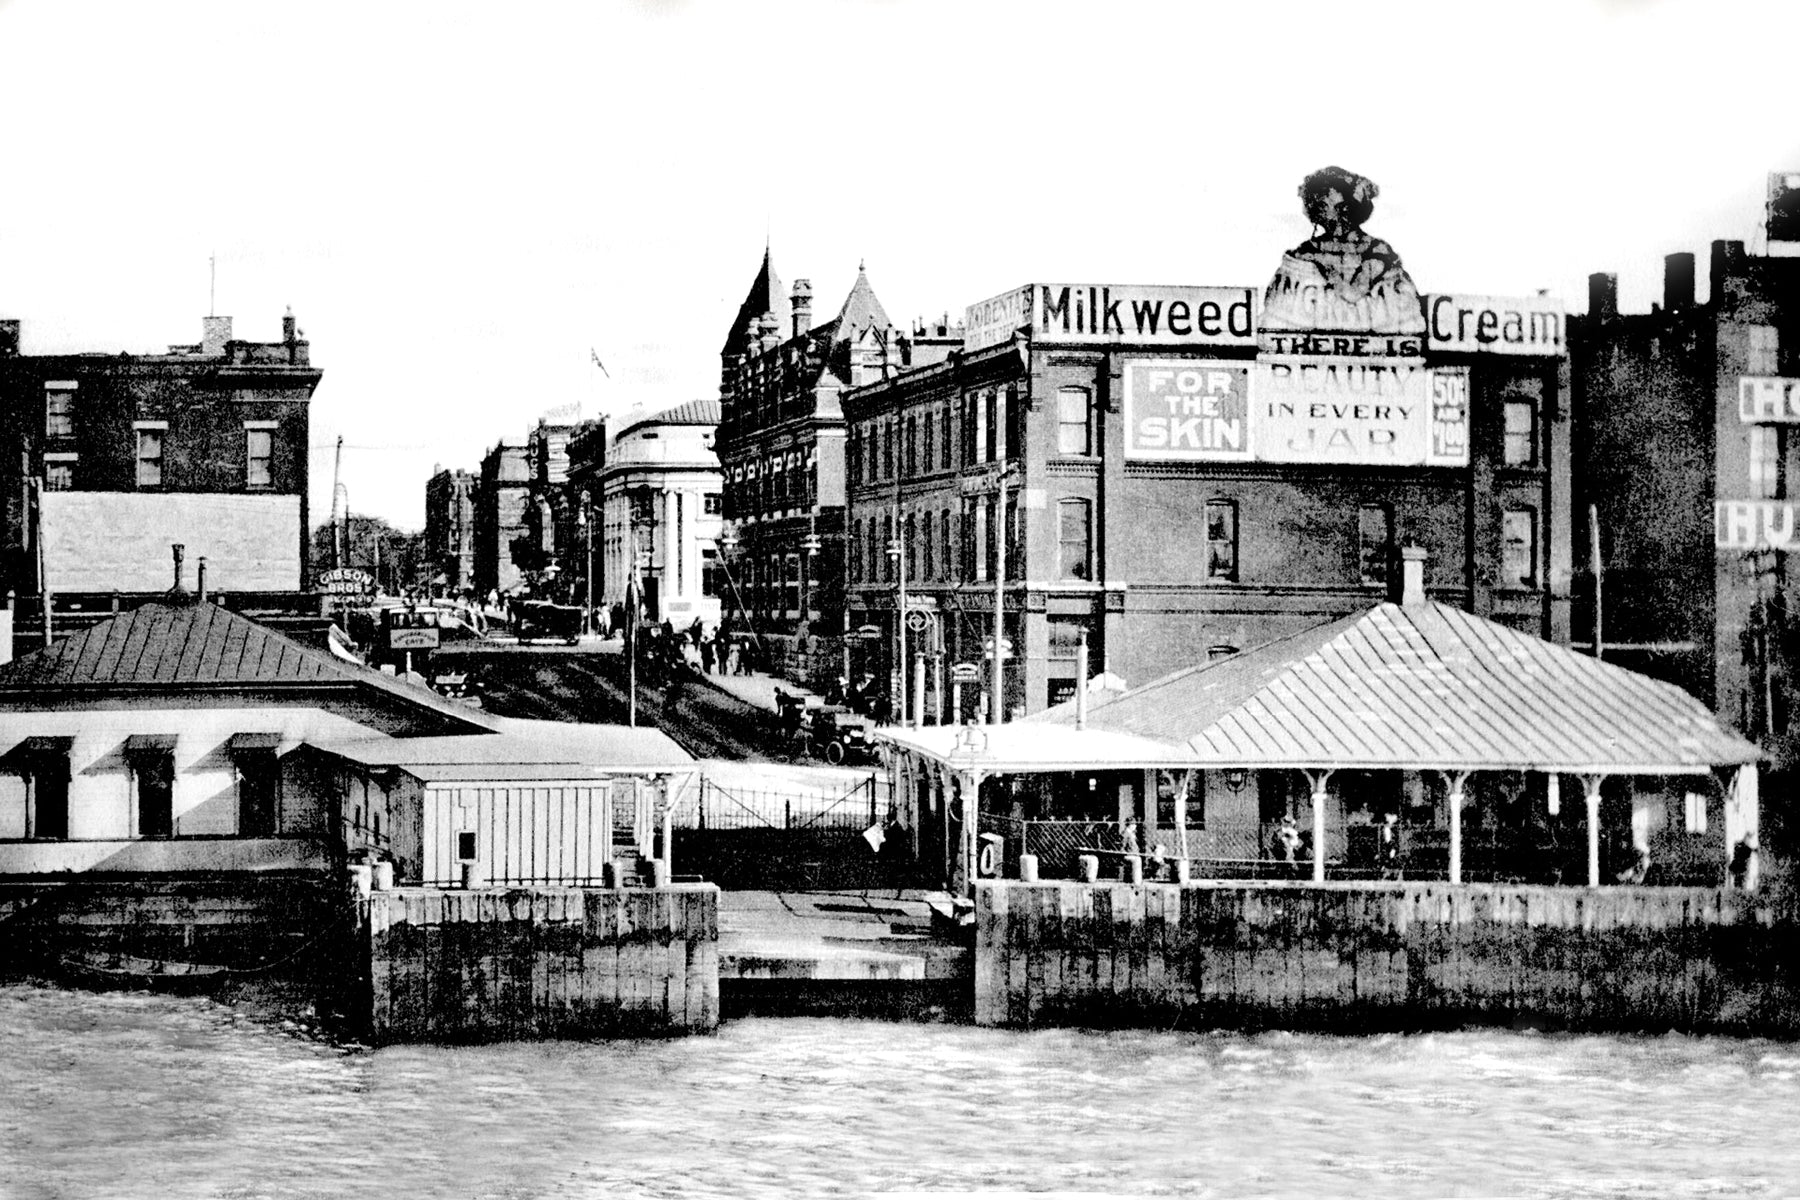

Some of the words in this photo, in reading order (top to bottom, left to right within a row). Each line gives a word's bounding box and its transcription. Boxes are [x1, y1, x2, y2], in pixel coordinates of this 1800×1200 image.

[1042, 286, 1252, 337] Milkweed
[1432, 296, 1559, 345] Cream
[1271, 337, 1369, 356] THERE
[1386, 339, 1420, 357] IS
[1148, 370, 1231, 394] FOR
[1271, 364, 1416, 395] BEAUTY
[1164, 395, 1219, 416] THE
[1268, 403, 1294, 418] IN
[1309, 403, 1414, 420] EVERY
[1139, 416, 1240, 448] SKIN
[1287, 428, 1396, 455] JAR
[320, 569, 375, 585] GIBSON
